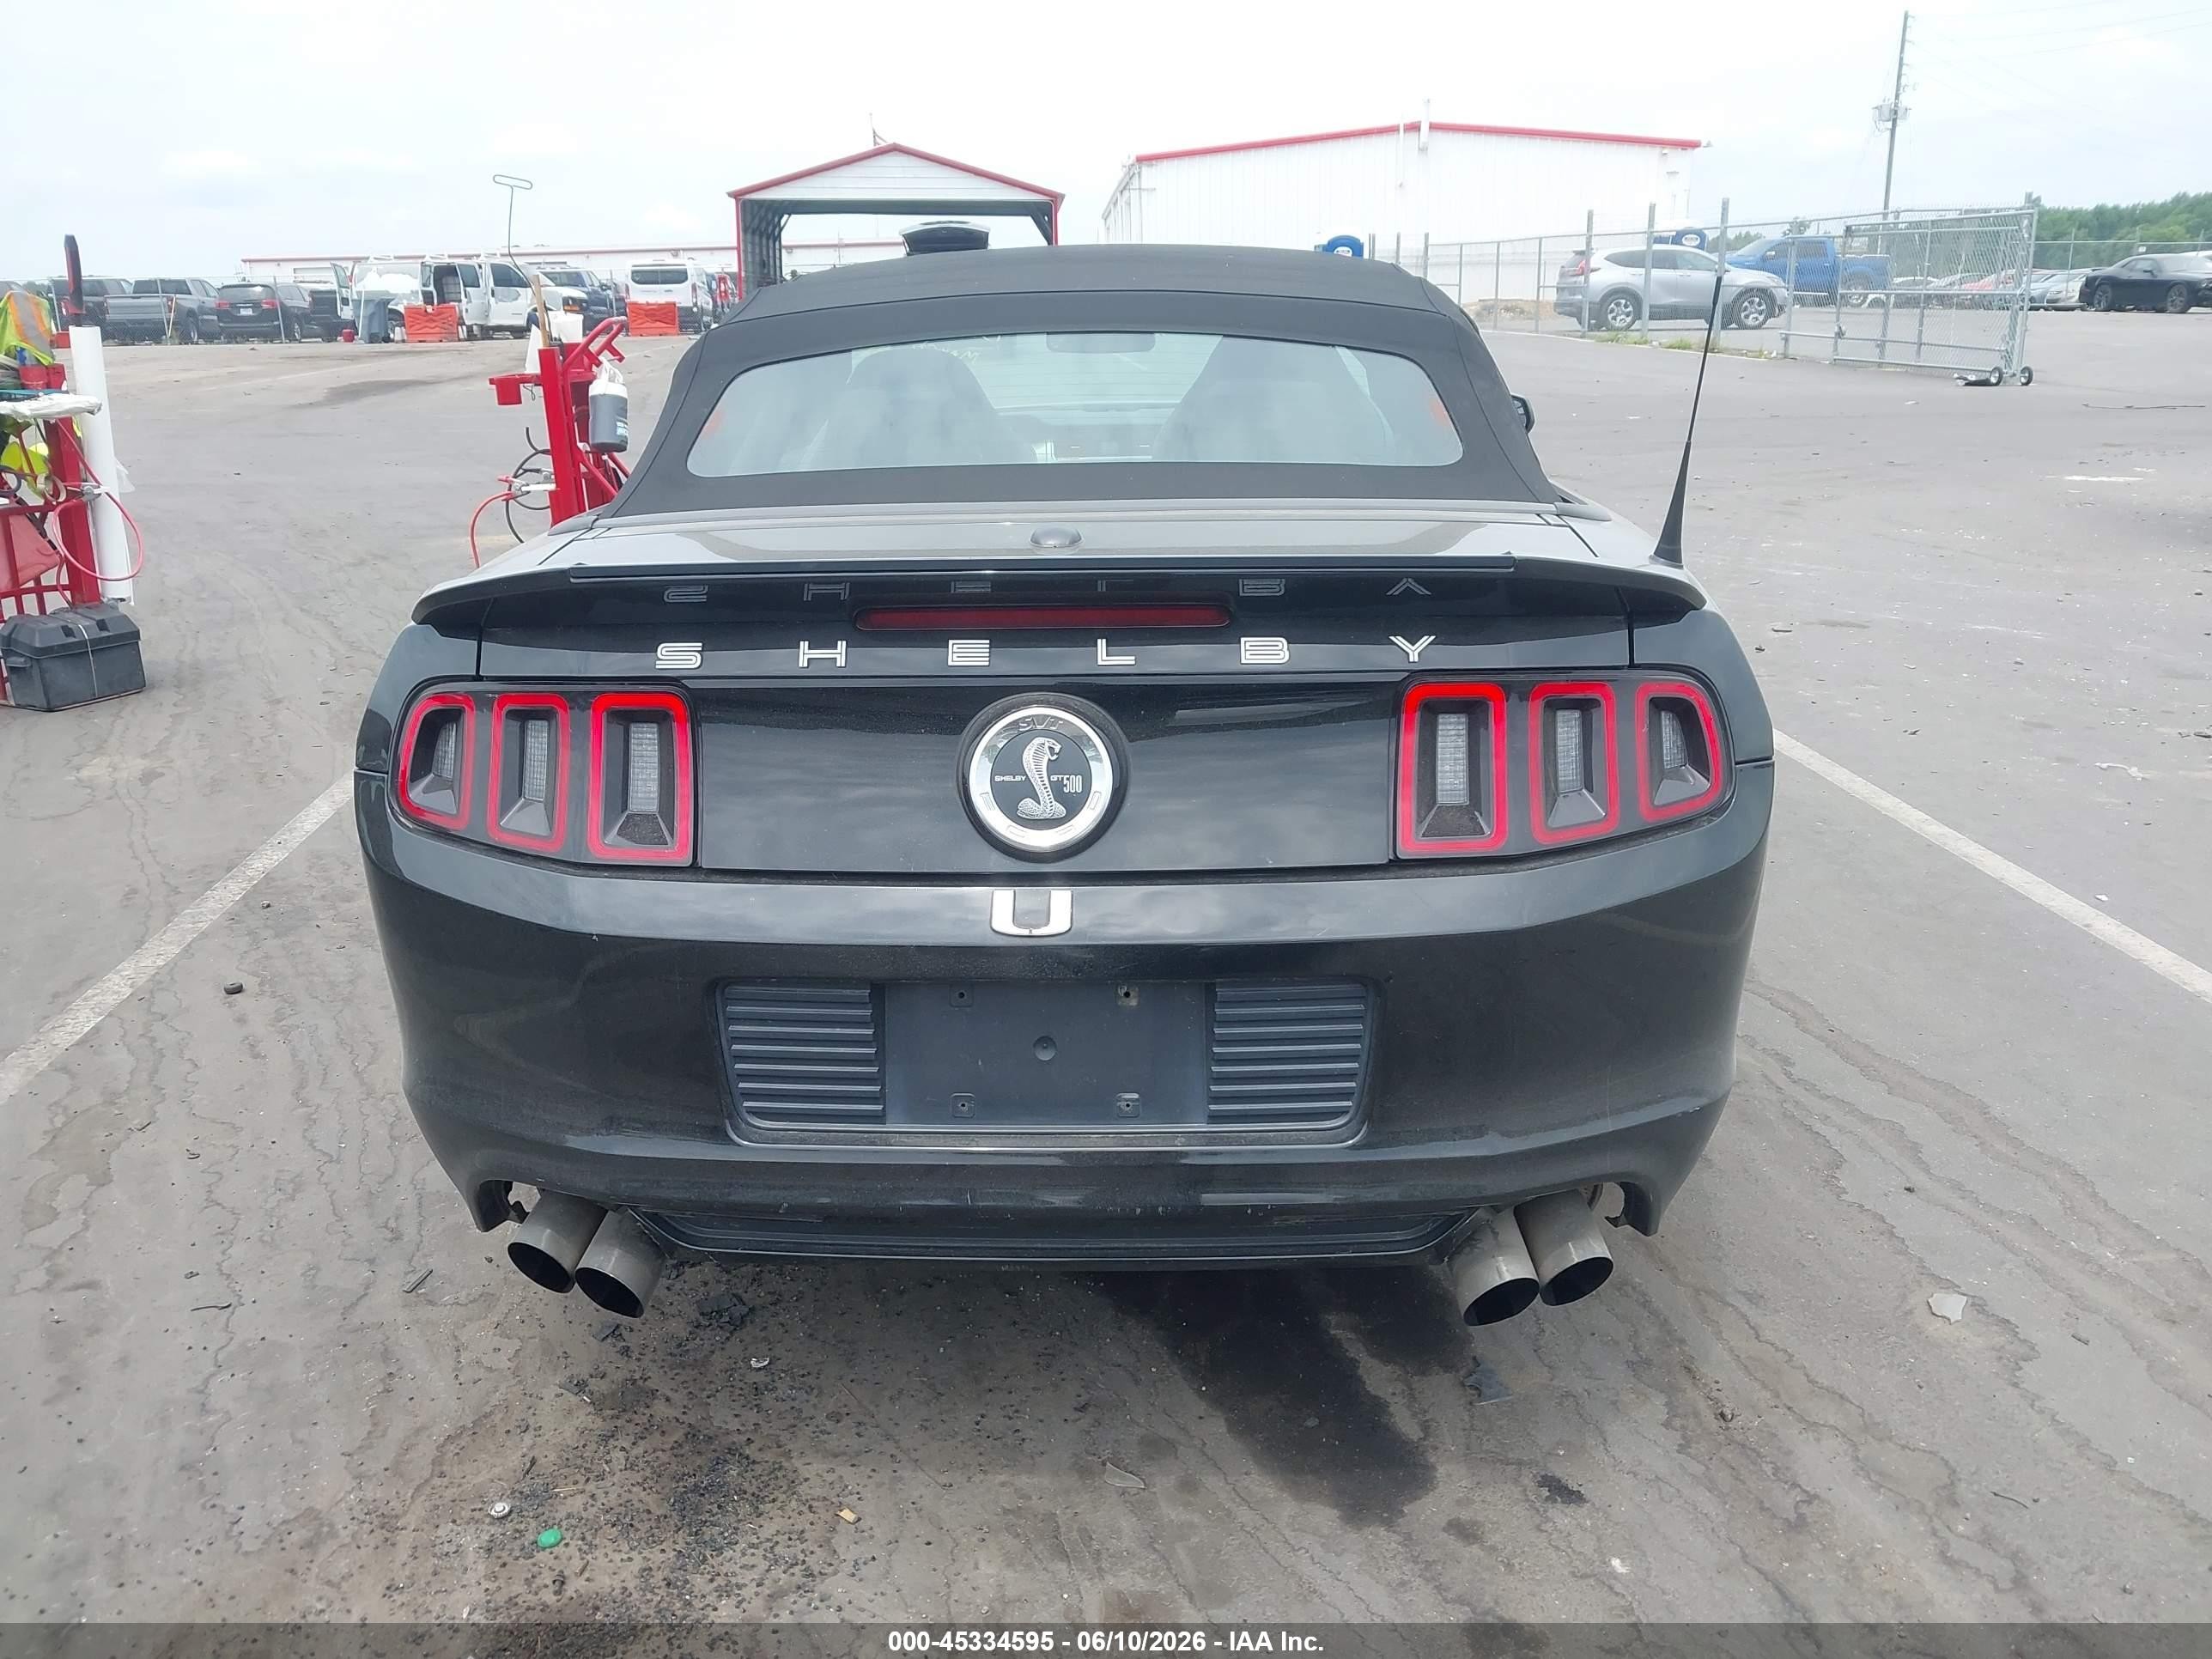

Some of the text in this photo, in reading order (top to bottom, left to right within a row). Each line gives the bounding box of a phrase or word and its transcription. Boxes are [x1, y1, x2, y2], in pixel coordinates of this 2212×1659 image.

[655, 636, 1437, 670] SHELBY
[1018, 716, 1064, 732] SVT
[991, 890, 1073, 937] U
